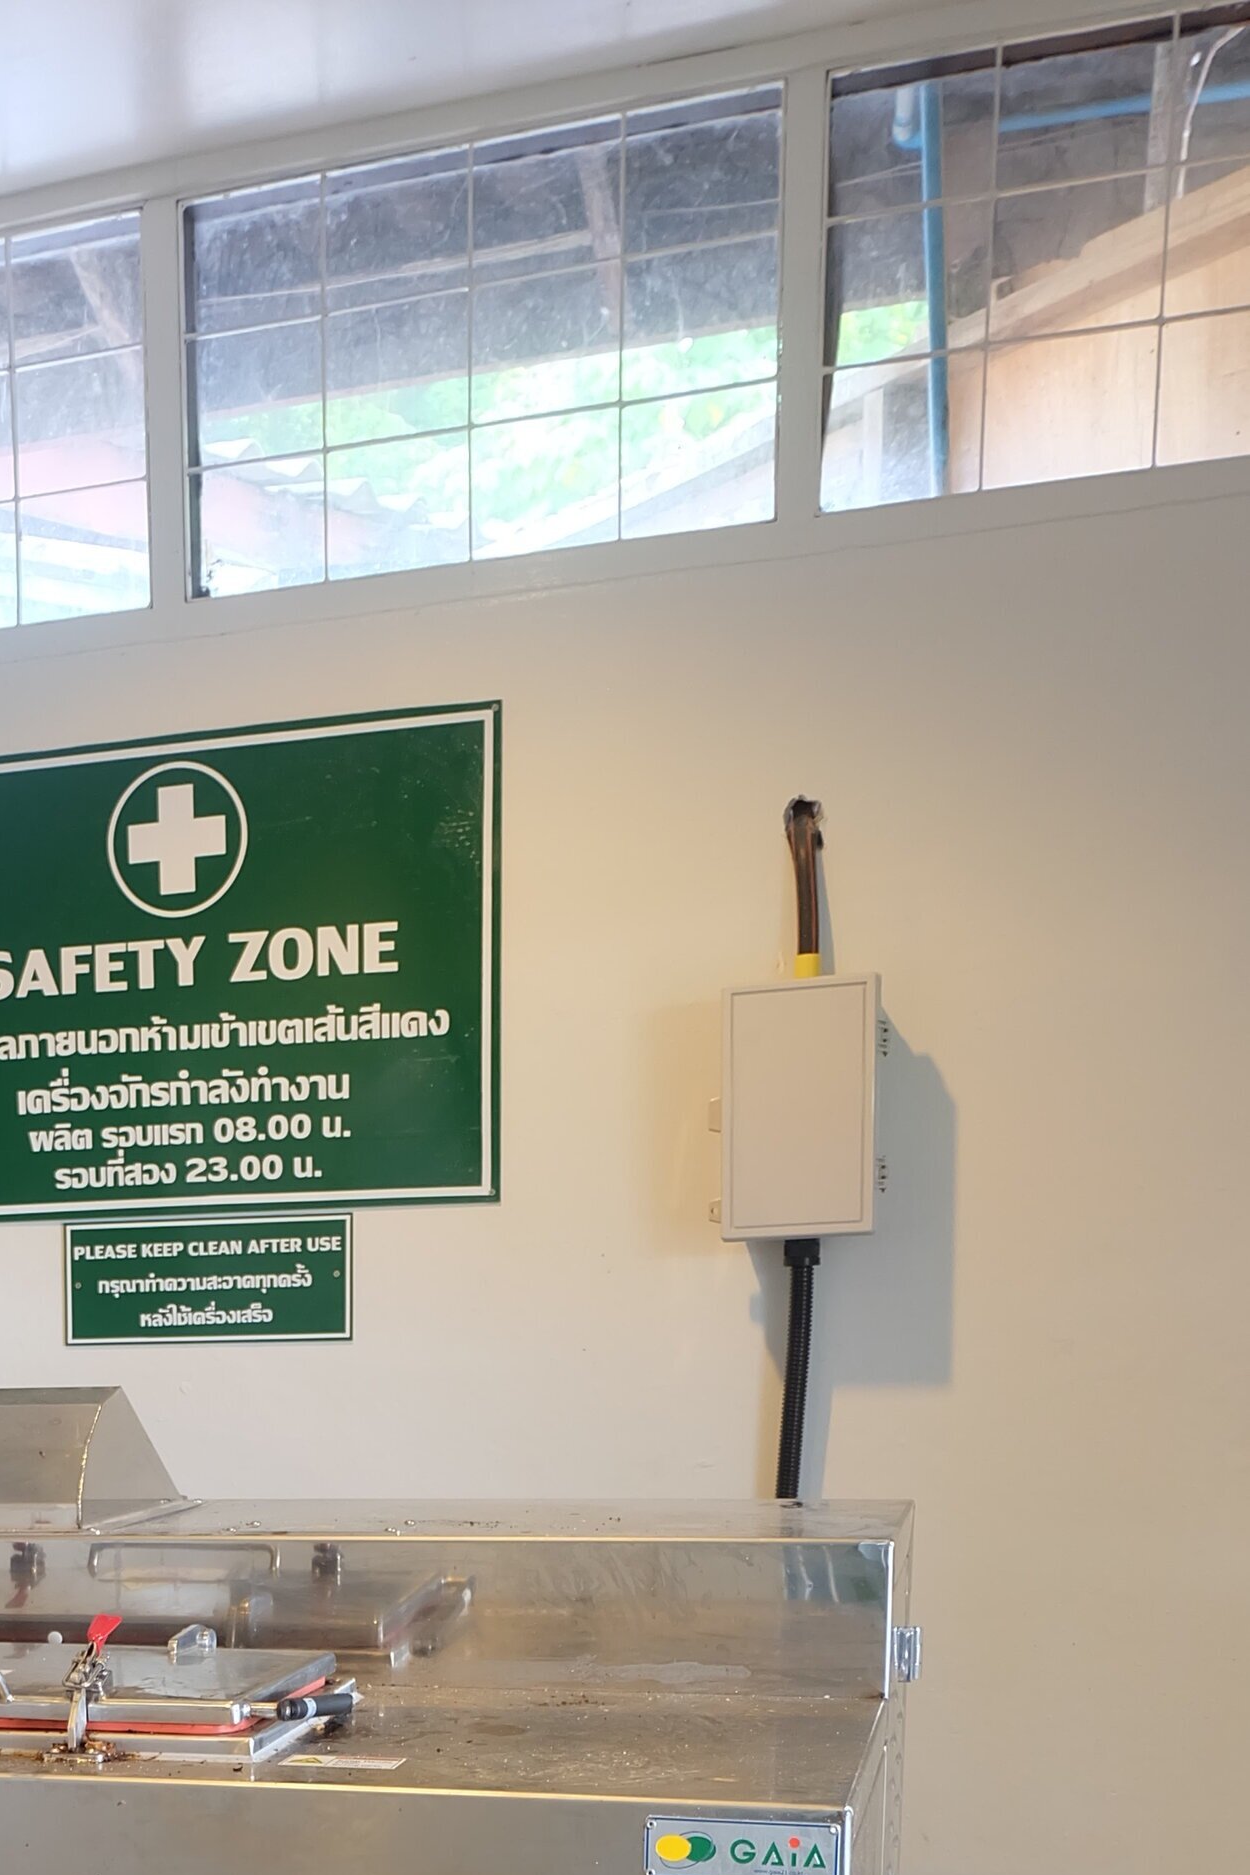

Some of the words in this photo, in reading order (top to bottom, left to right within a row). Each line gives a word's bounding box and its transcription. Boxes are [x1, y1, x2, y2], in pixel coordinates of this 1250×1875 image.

[228, 921, 399, 983] ZONE
[16, 1067, 350, 1115] เครื่องจักรกำลังทำงาน
[28, 1122, 93, 1153] ผลิต
[101, 1121, 204, 1149] รอบแรก
[213, 1113, 312, 1144] 08.00
[322, 1115, 352, 1138] น.
[54, 1149, 177, 1190] รอบที่สอง
[185, 1154, 284, 1183] 23.00
[293, 1156, 323, 1179] น.
[73, 1243, 138, 1261] PLEASE
[141, 1241, 184, 1258] KEEP
[187, 1239, 243, 1257] CLEAN
[247, 1237, 303, 1255] AFTER
[306, 1235, 342, 1252] USE
[97, 1263, 313, 1298] กรุณาทำความสะอาดทุกครั้ง
